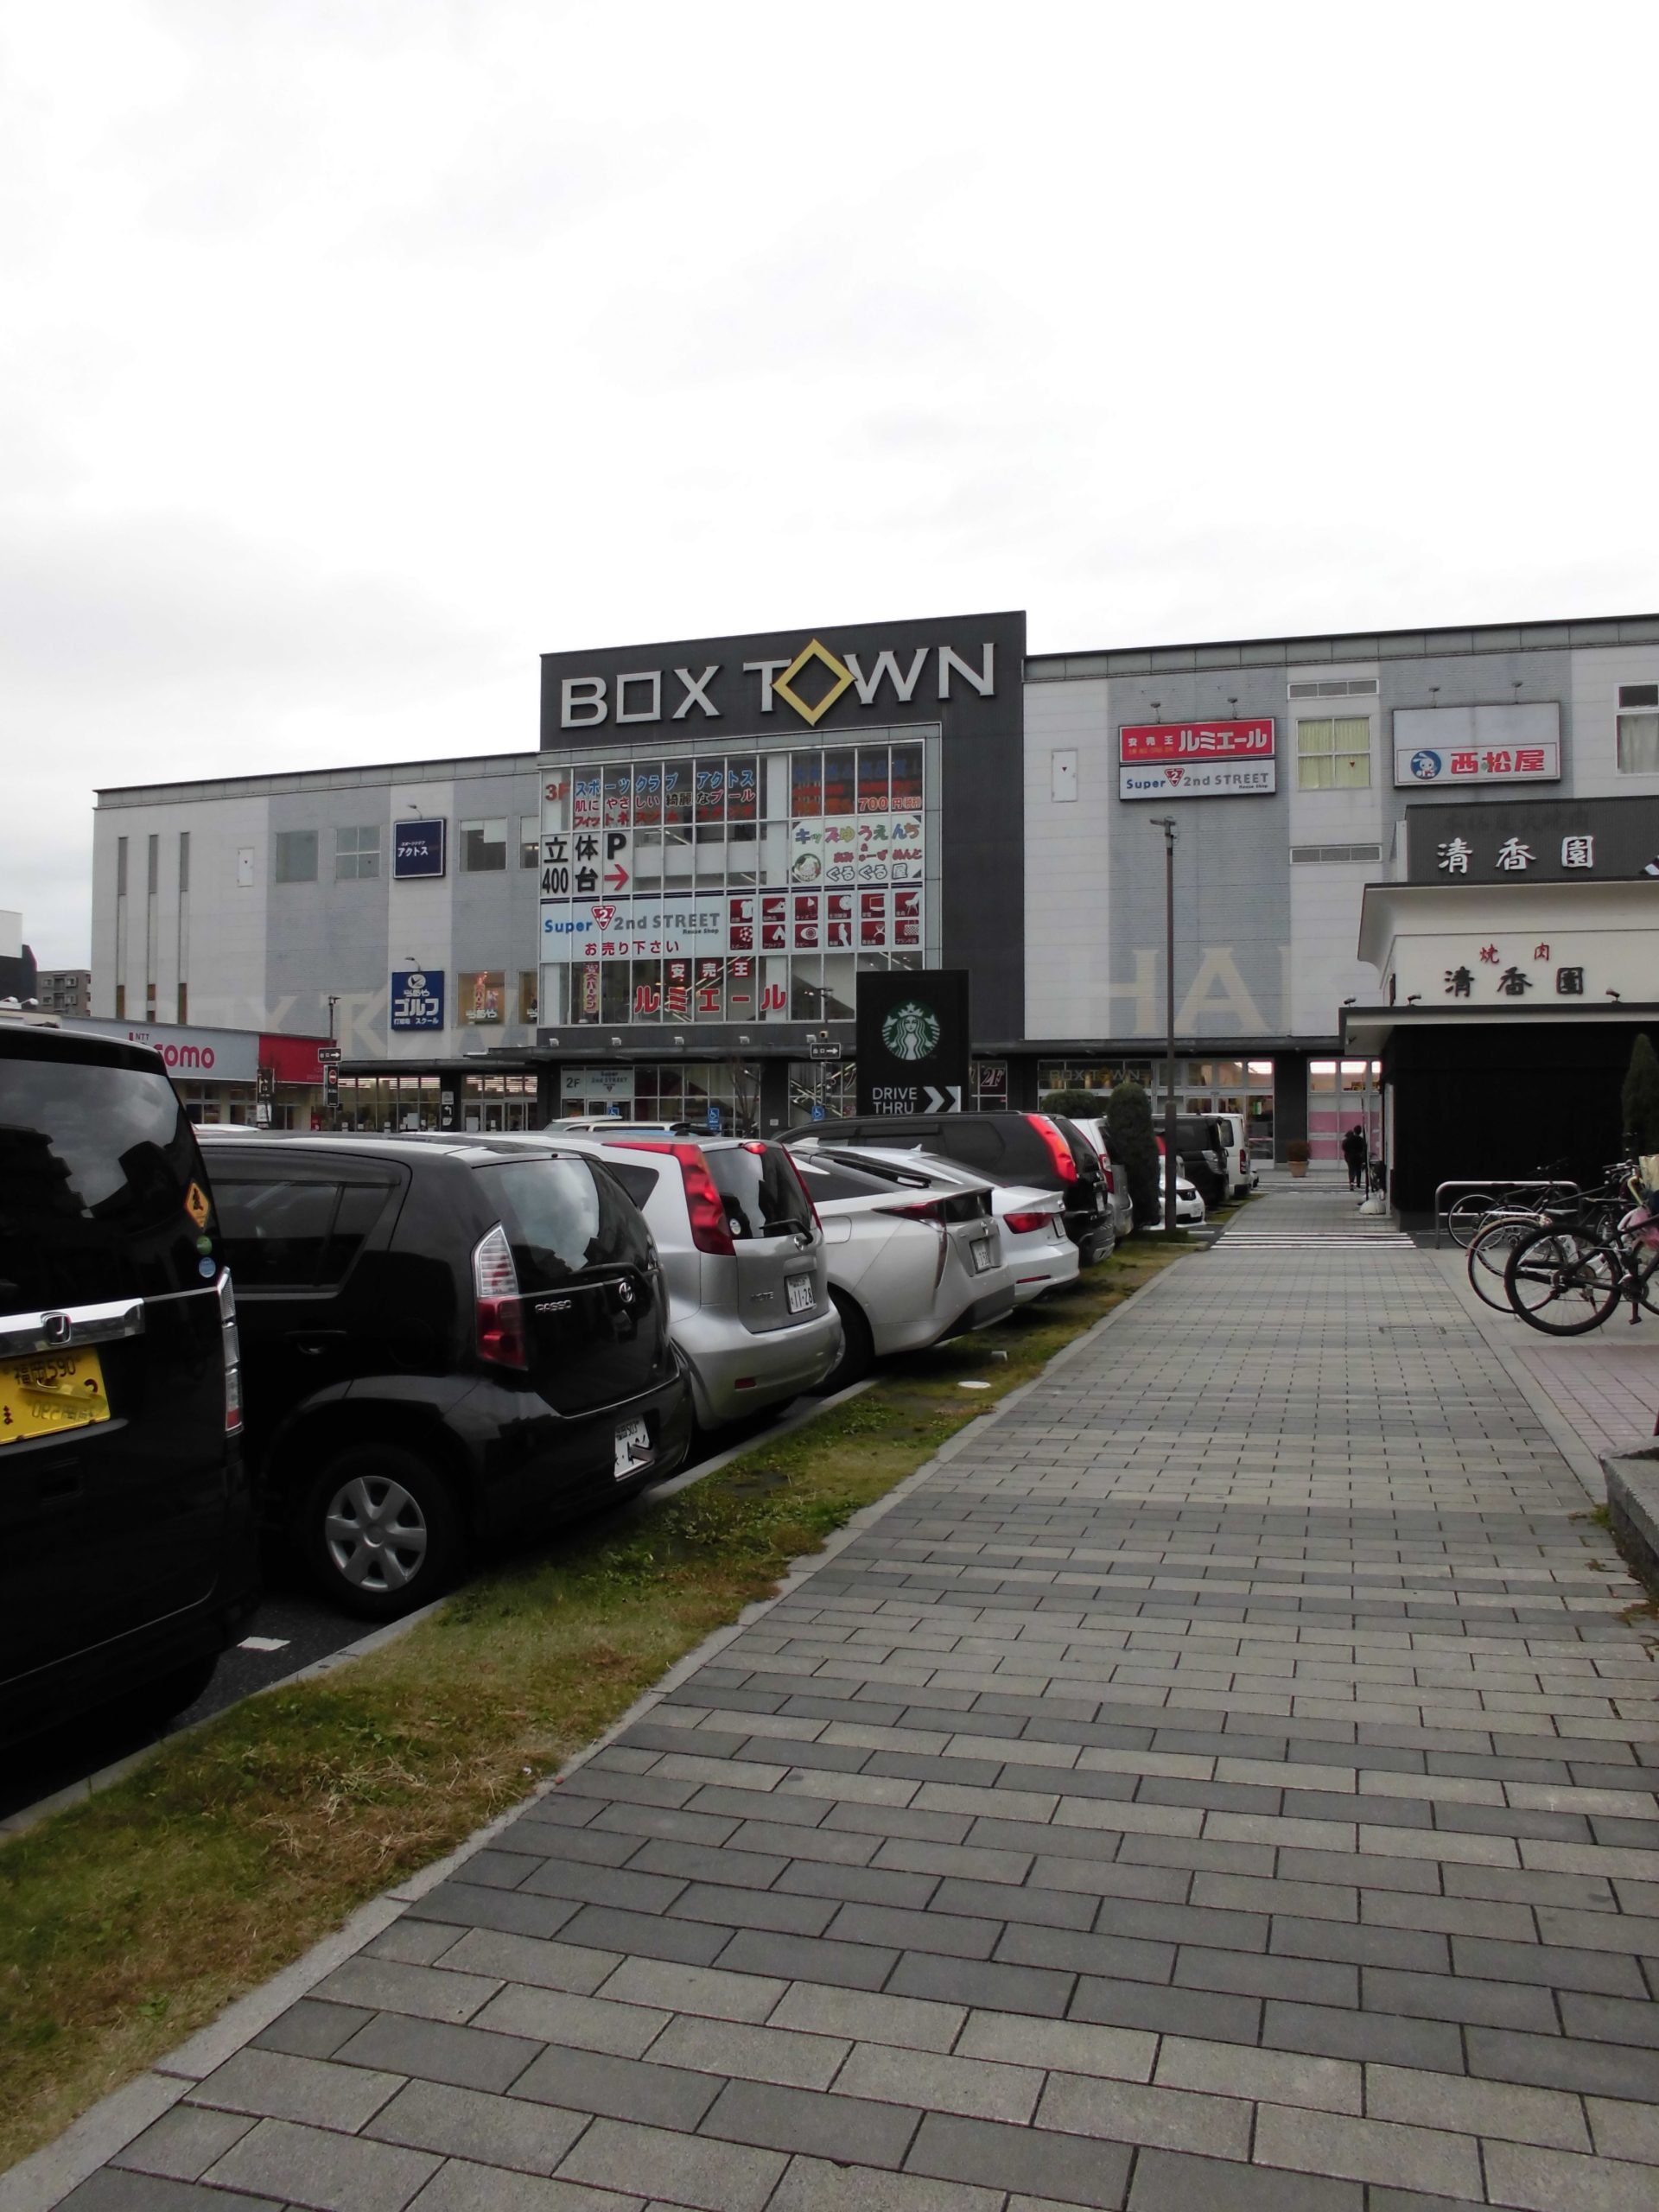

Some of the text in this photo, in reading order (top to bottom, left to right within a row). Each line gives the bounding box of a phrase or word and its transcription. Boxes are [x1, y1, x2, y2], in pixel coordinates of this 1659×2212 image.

[561, 638, 995, 728] BOX TOWN
[1179, 728, 1267, 753] ルミエール
[1451, 749, 1545, 774] 西松屋
[545, 770, 753, 801] 3F スポーツクラブ アクトス
[1126, 778, 1166, 790] Super
[1184, 775, 1210, 786] 2nd
[1214, 773, 1268, 785] STREET
[397, 847, 429, 857] アクトス
[1437, 836, 1594, 874] 清香園
[542, 866, 599, 893] 400台
[544, 918, 593, 934] Super
[613, 916, 647, 931] 2nd
[652, 913, 720, 929] STREET
[585, 940, 679, 956] お売り下さい
[1480, 943, 1550, 963] 焼肉
[671, 963, 747, 978] 安売王
[1445, 966, 1584, 997] 清香園
[395, 998, 439, 1017] ゴルフ
[635, 983, 786, 1014] ルミエール
[566, 1077, 581, 1089] 2F
[1049, 1070, 1085, 1081] BOX
[873, 1087, 918, 1101] DRIVE
[872, 1102, 914, 1115] THRU
